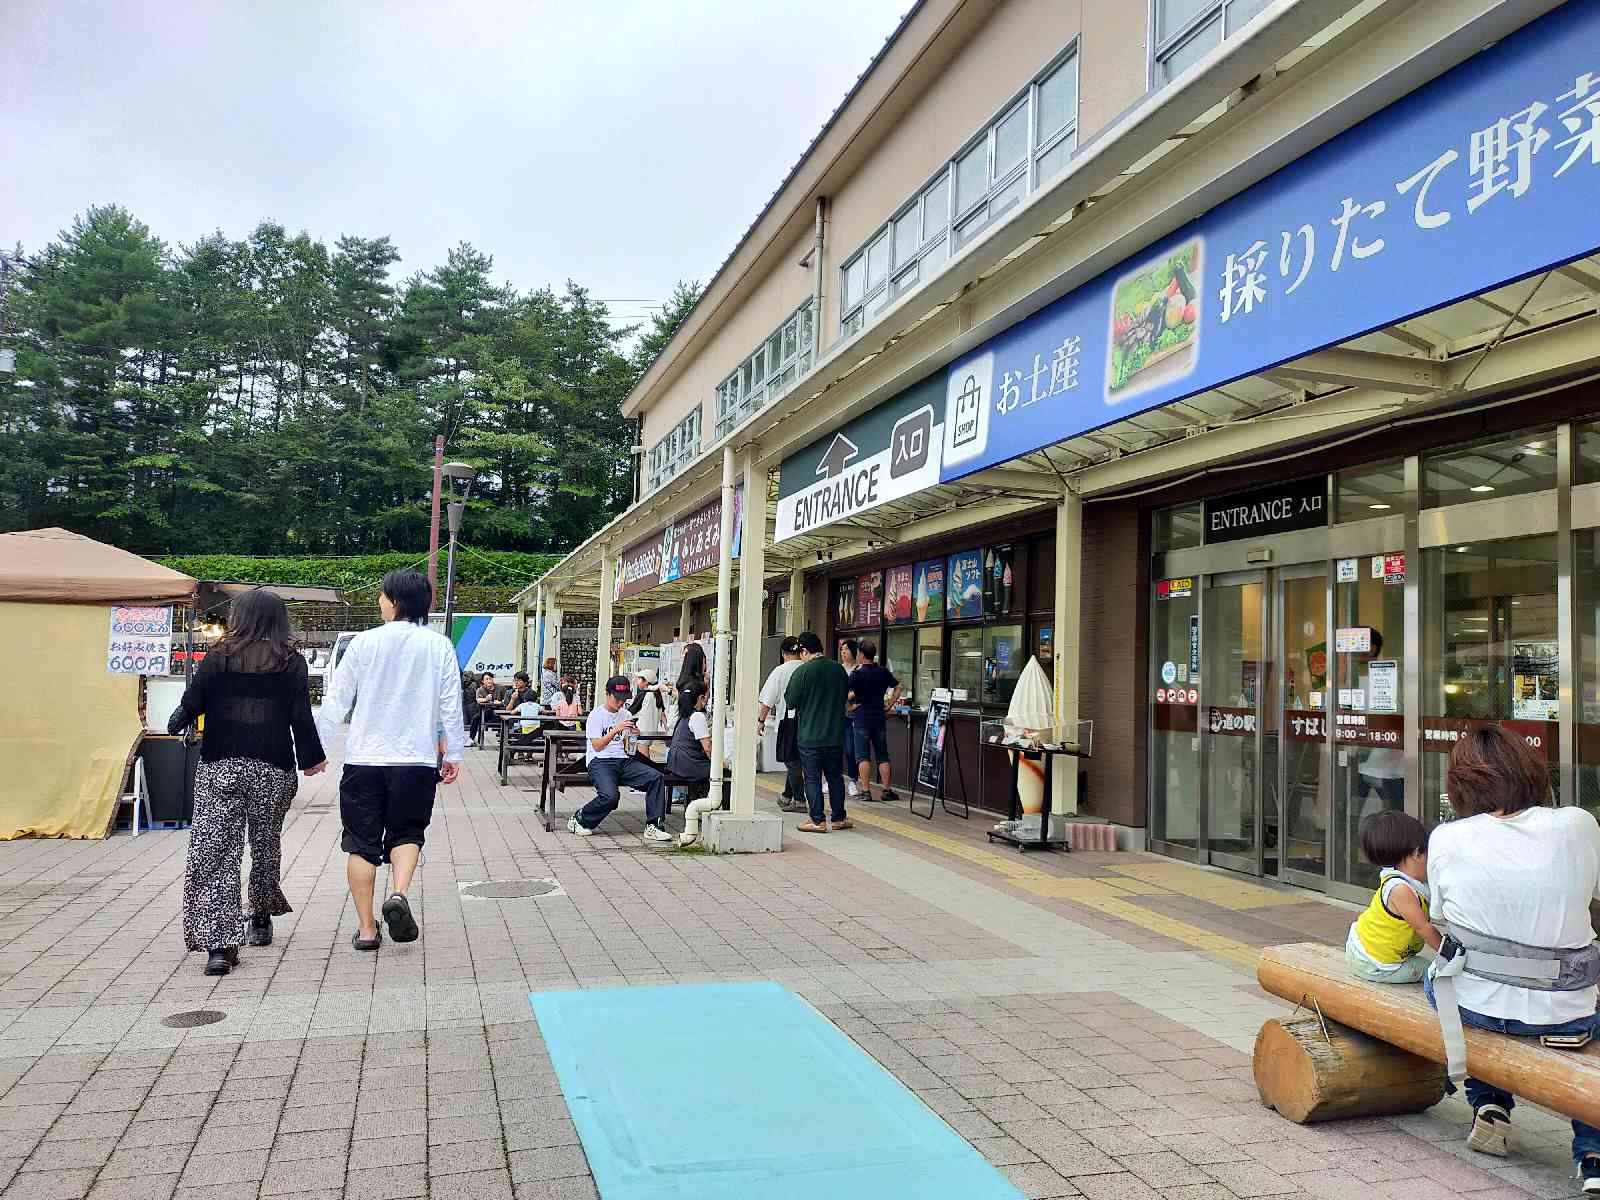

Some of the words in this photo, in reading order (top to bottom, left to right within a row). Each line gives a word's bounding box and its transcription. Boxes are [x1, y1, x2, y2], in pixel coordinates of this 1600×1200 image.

[996, 335, 1081, 417] お土産
[957, 420, 975, 437] SHOP
[895, 428, 924, 466] 入口
[794, 463, 881, 531] ENTRANCE
[1211, 497, 1293, 531] ENTRANCE
[1299, 495, 1322, 514] 入口
[110, 655, 166, 672] 600円
[1336, 729, 1357, 739] 9:00
[1369, 731, 1397, 742] 18:00
